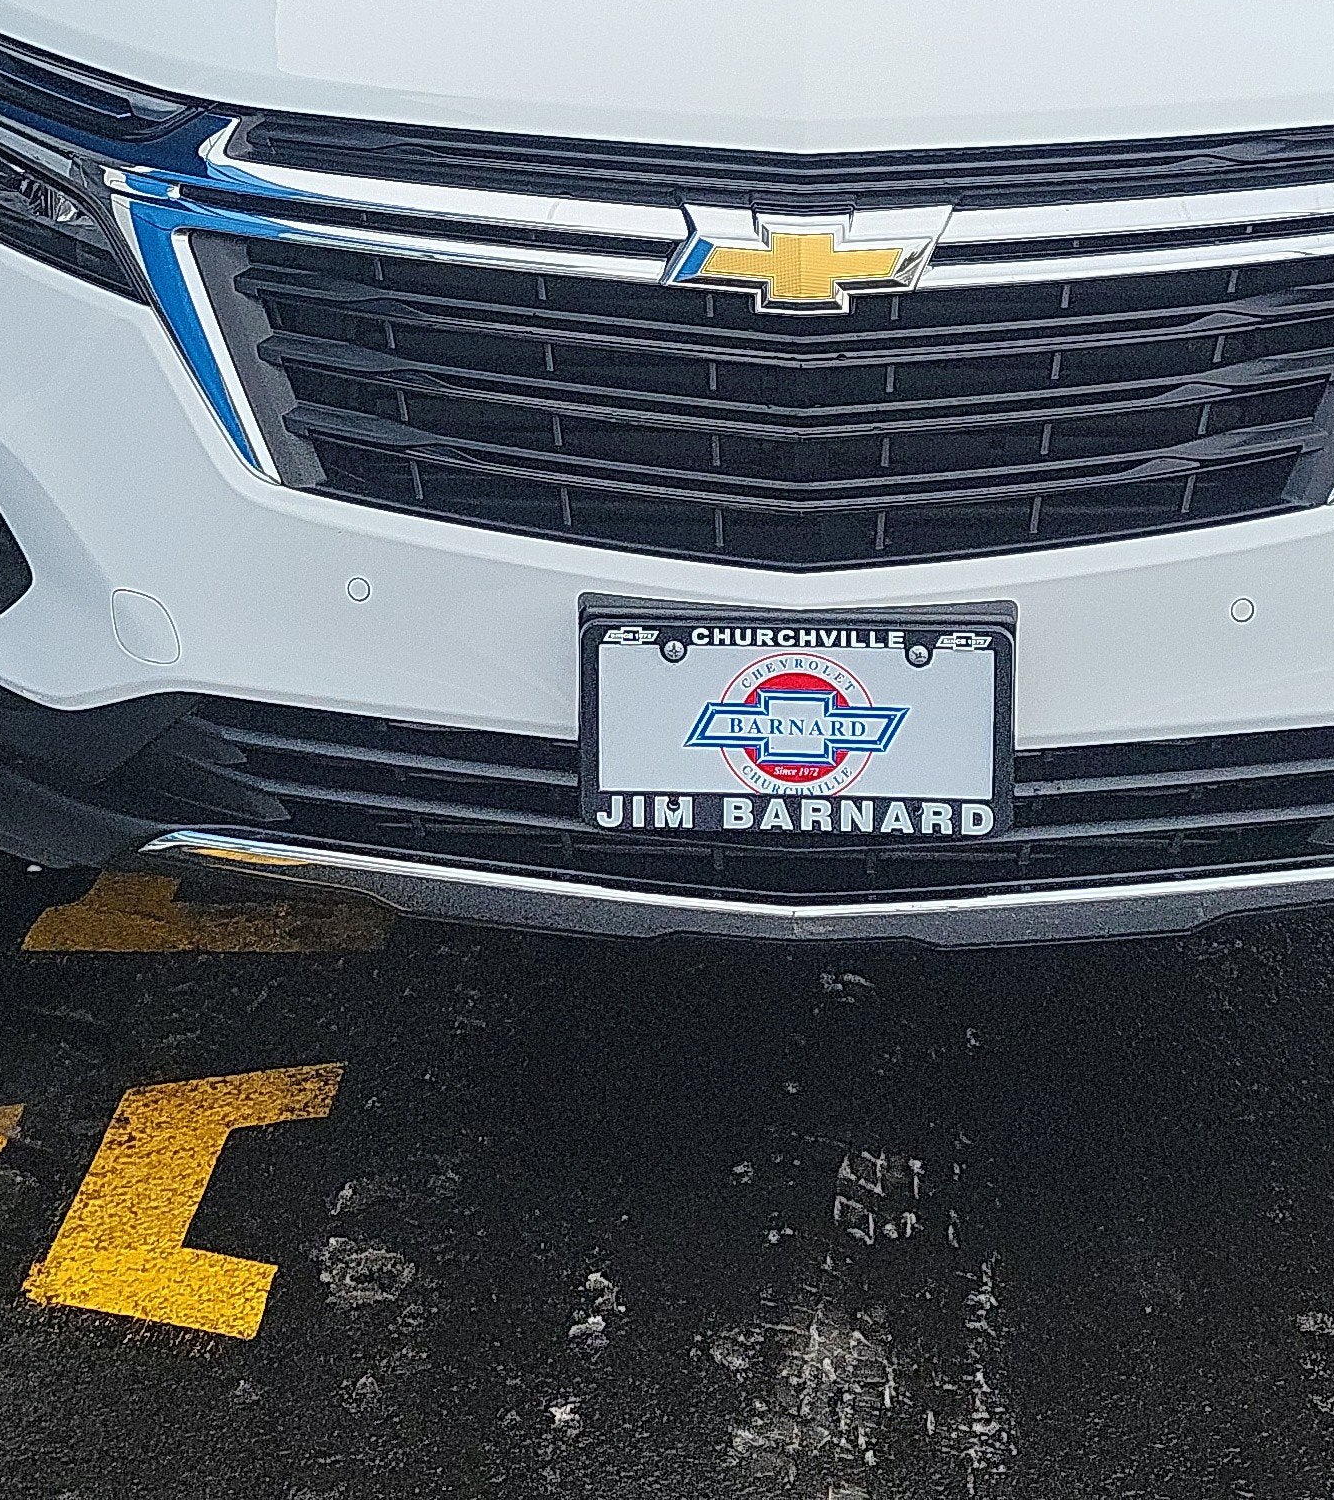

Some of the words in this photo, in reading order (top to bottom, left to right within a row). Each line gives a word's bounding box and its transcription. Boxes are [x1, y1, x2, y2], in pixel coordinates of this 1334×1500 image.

[691, 627, 906, 650] CHURCHVILLE
[741, 658, 856, 691] CHEVROLET
[729, 717, 866, 737] BARNARD
[742, 765, 853, 795] CHURCHVILLE
[773, 766, 797, 775] Since
[798, 767, 820, 776] 1972
[596, 796, 693, 829] JIM
[723, 798, 995, 836] BARNARD
